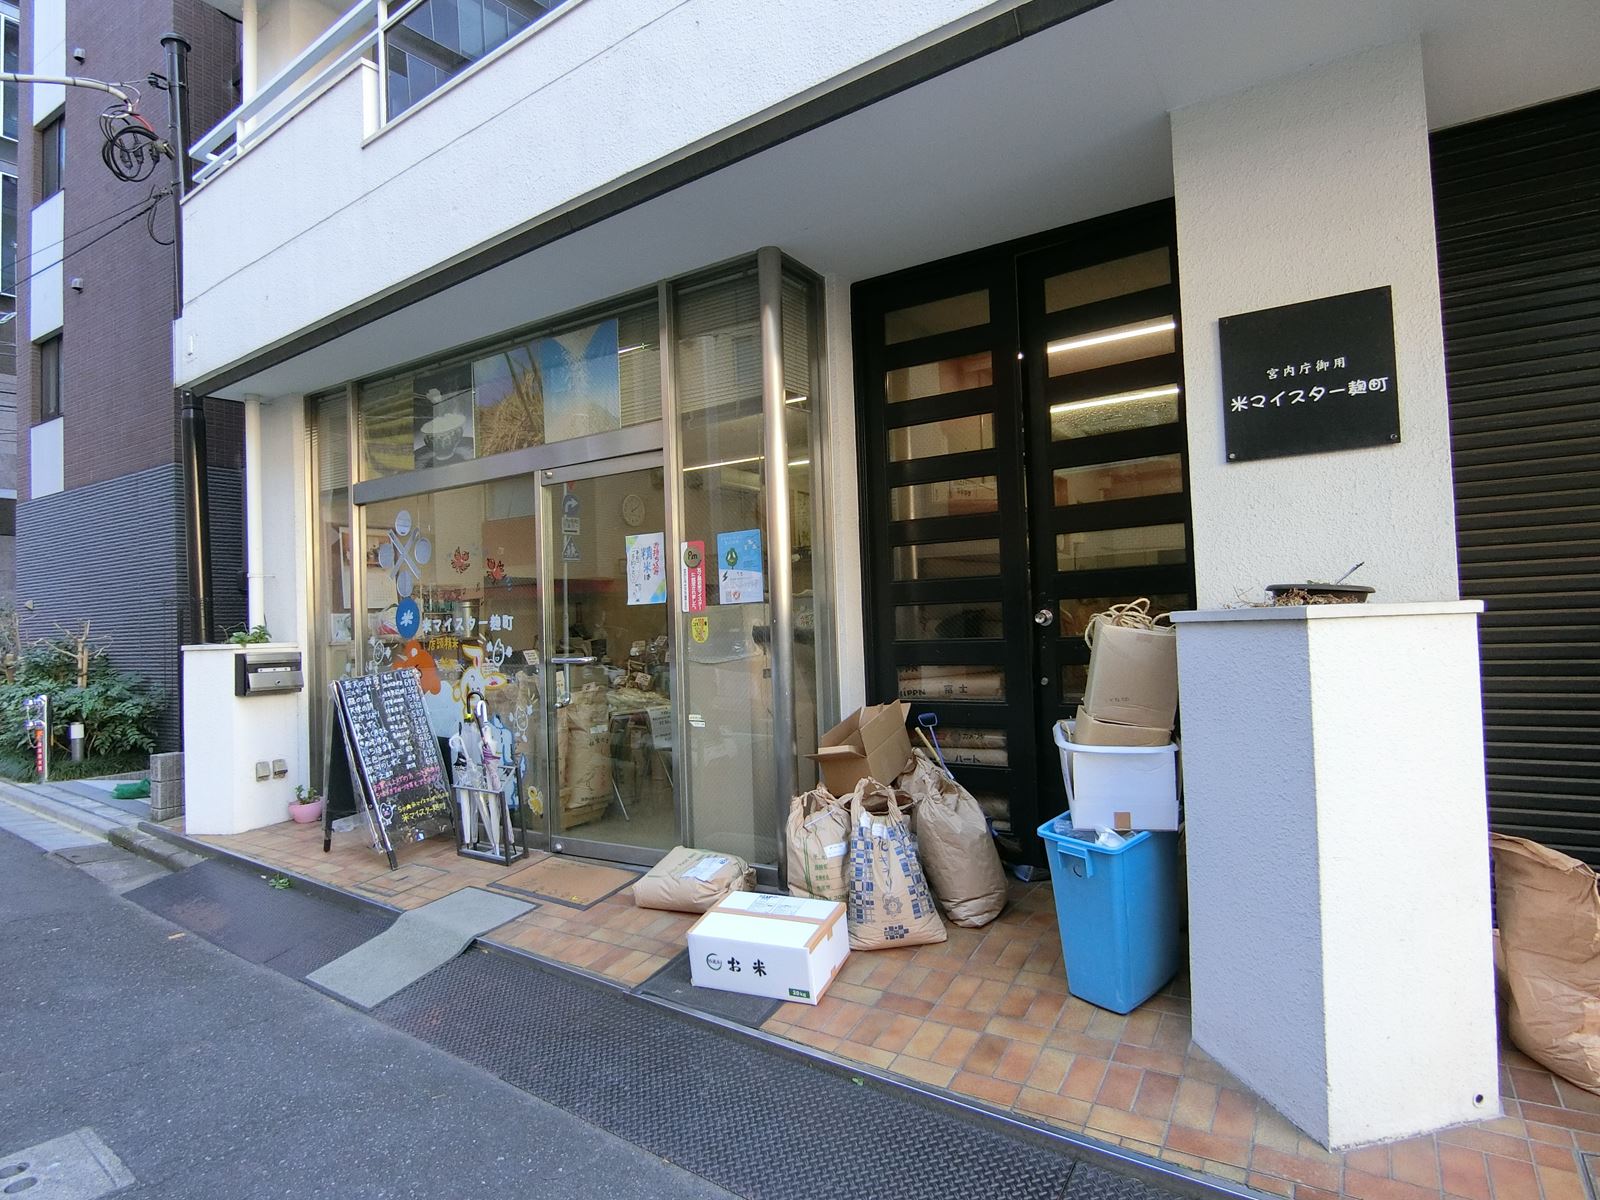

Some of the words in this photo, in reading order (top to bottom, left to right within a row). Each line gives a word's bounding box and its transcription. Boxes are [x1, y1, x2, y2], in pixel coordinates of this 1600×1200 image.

[1266, 356, 1346, 380] 宮内庁御用
[1230, 376, 1389, 412] 米マイスター麹町
[400, 609, 414, 627] 米
[422, 614, 514, 634] 米マイスター麹町
[727, 956, 768, 977] お米
